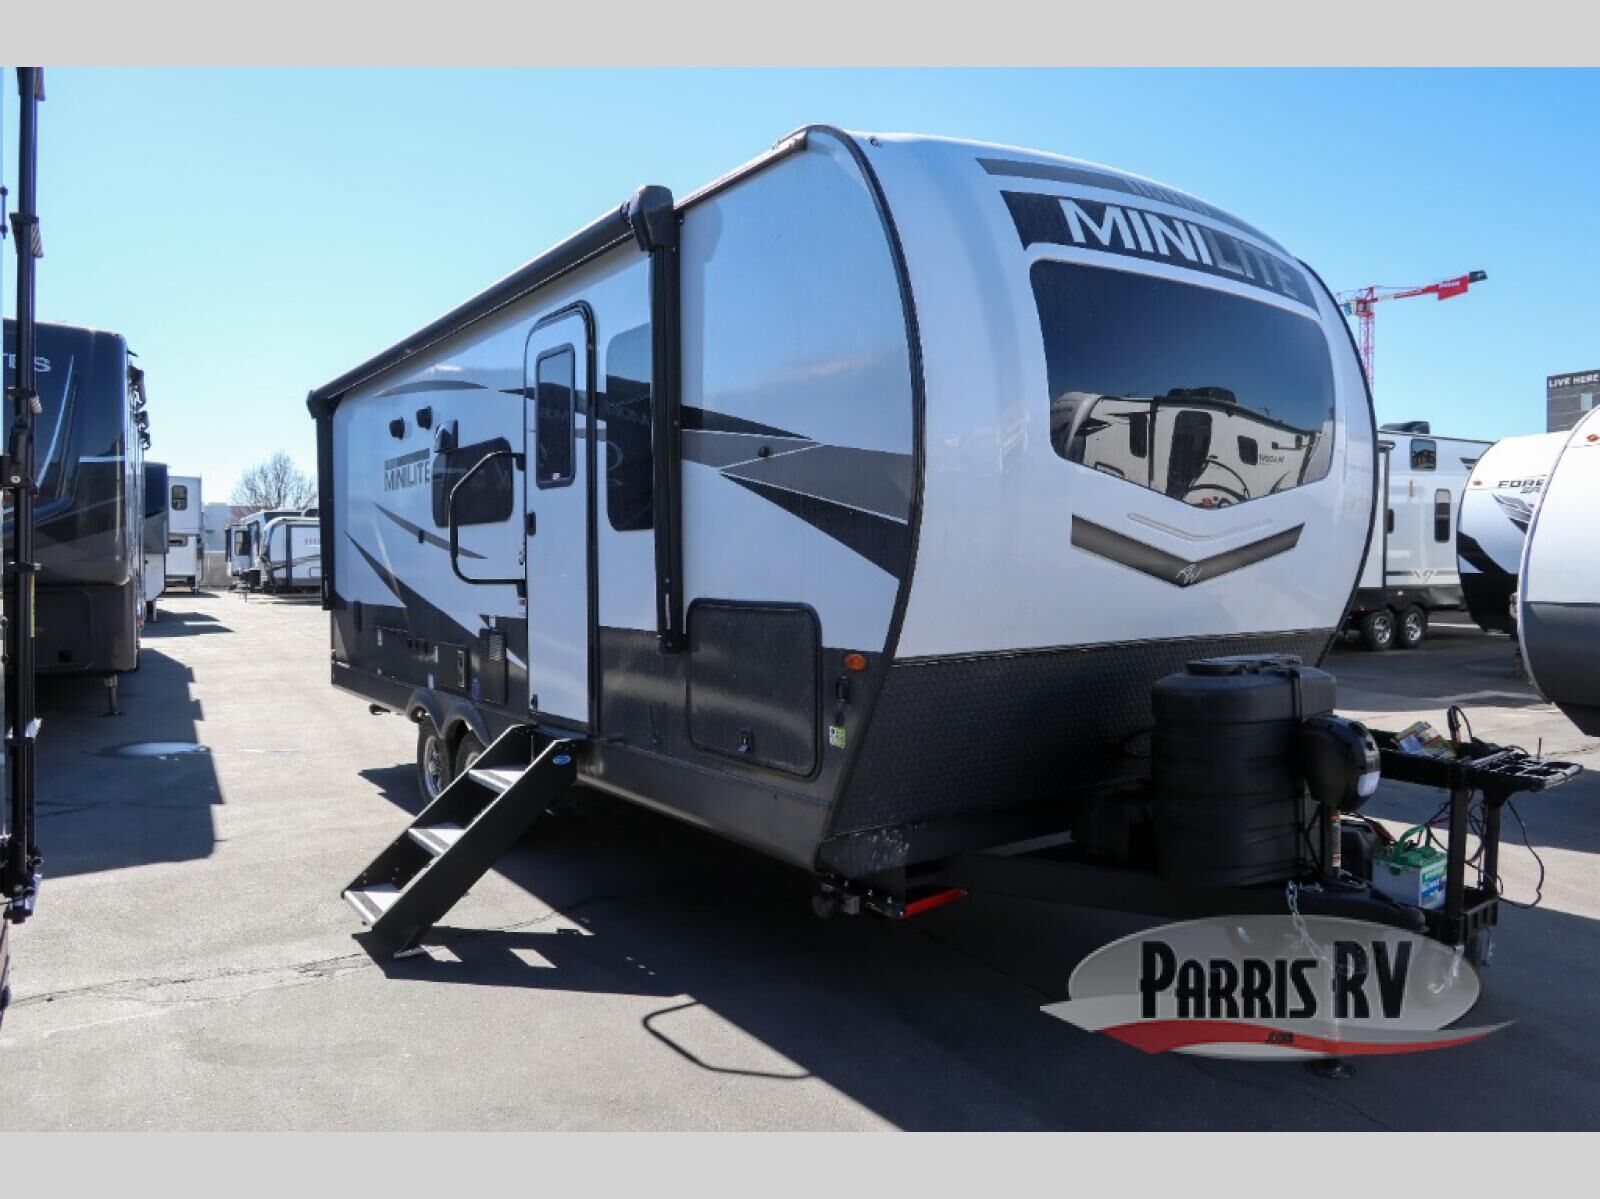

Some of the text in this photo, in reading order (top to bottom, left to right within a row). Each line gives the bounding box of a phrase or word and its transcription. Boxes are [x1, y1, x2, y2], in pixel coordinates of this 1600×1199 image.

[1058, 198, 1299, 299] MINILITE
[1548, 372, 1599, 388] LIVE HERE
[384, 460, 430, 492] MINILITE
